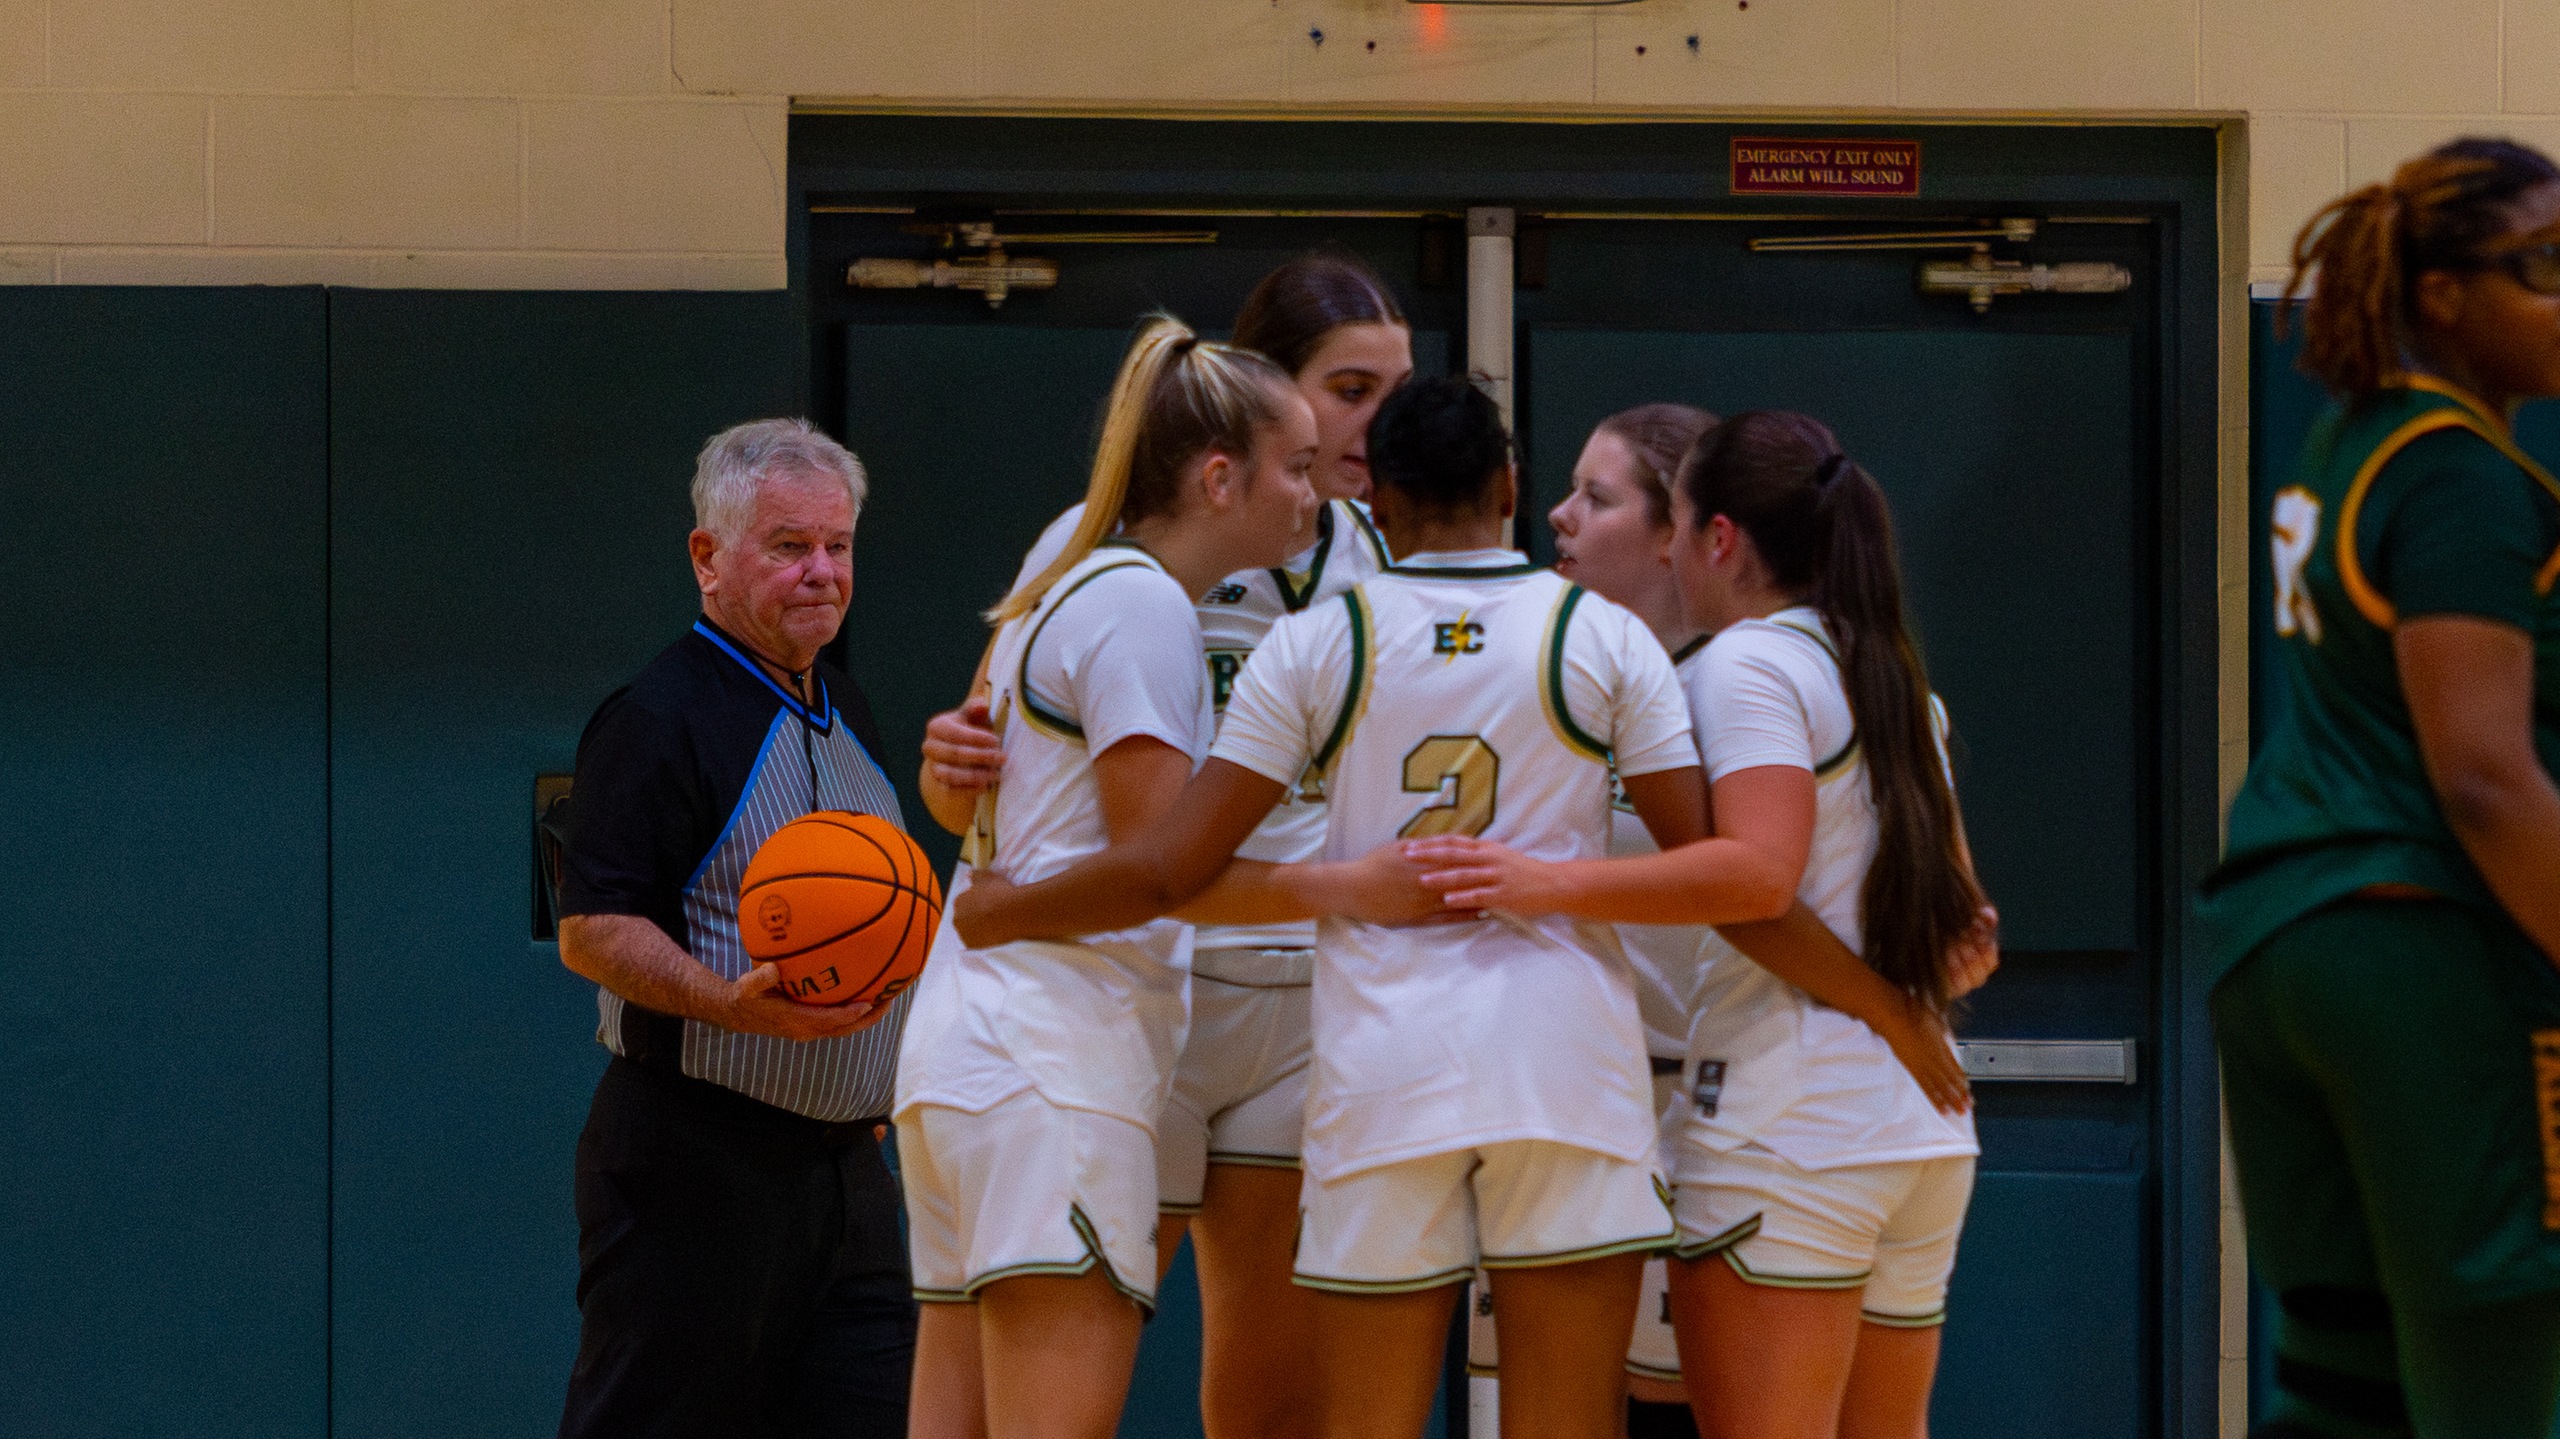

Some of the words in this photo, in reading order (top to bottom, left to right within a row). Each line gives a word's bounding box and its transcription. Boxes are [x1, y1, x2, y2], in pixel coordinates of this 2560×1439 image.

[1737, 149, 1830, 165] EMERGENCY
[1835, 150, 1869, 165] EXIT
[1873, 150, 1913, 166] ONLY
[1749, 168, 1805, 183] ALARM
[1809, 169, 1848, 184] WILL
[1851, 169, 1904, 185] SOUND
[1433, 622, 1486, 654] EC
[1397, 735, 1499, 838] 2
